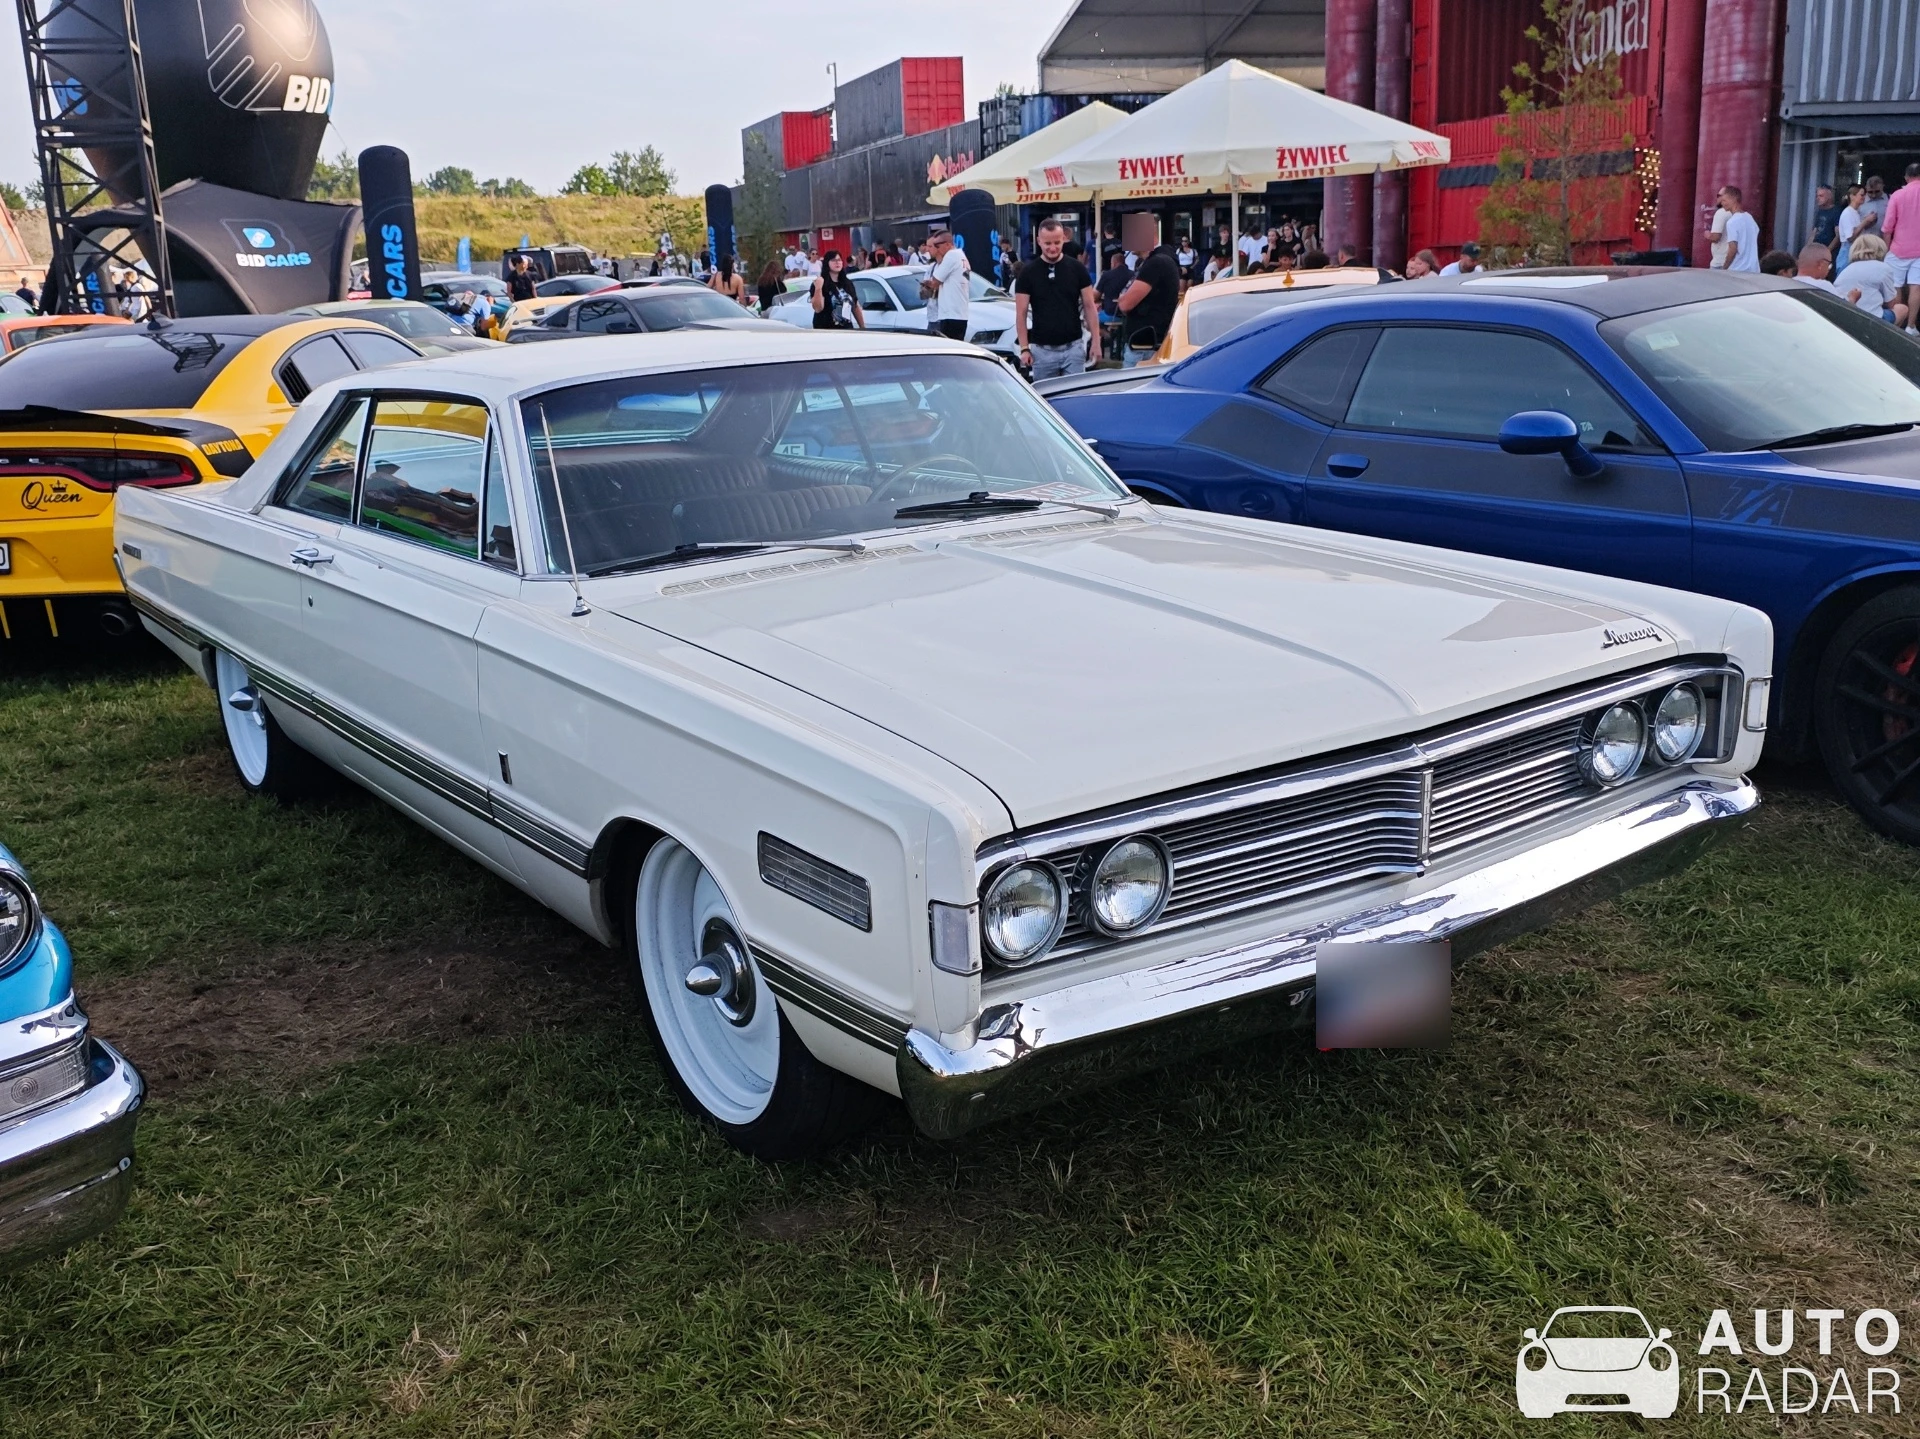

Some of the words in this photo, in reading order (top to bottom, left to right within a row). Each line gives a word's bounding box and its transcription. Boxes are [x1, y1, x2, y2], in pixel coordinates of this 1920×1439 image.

[283, 74, 333, 114] BID
[1118, 154, 1186, 180] ŻYWIEC
[1276, 144, 1349, 170] ŻYWIEC
[235, 252, 312, 267] BIDCARS
[381, 224, 407, 300] CARS
[201, 439, 245, 456] DAYTONA
[21, 481, 83, 512] Queen
[1601, 627, 1662, 650] Mercury
